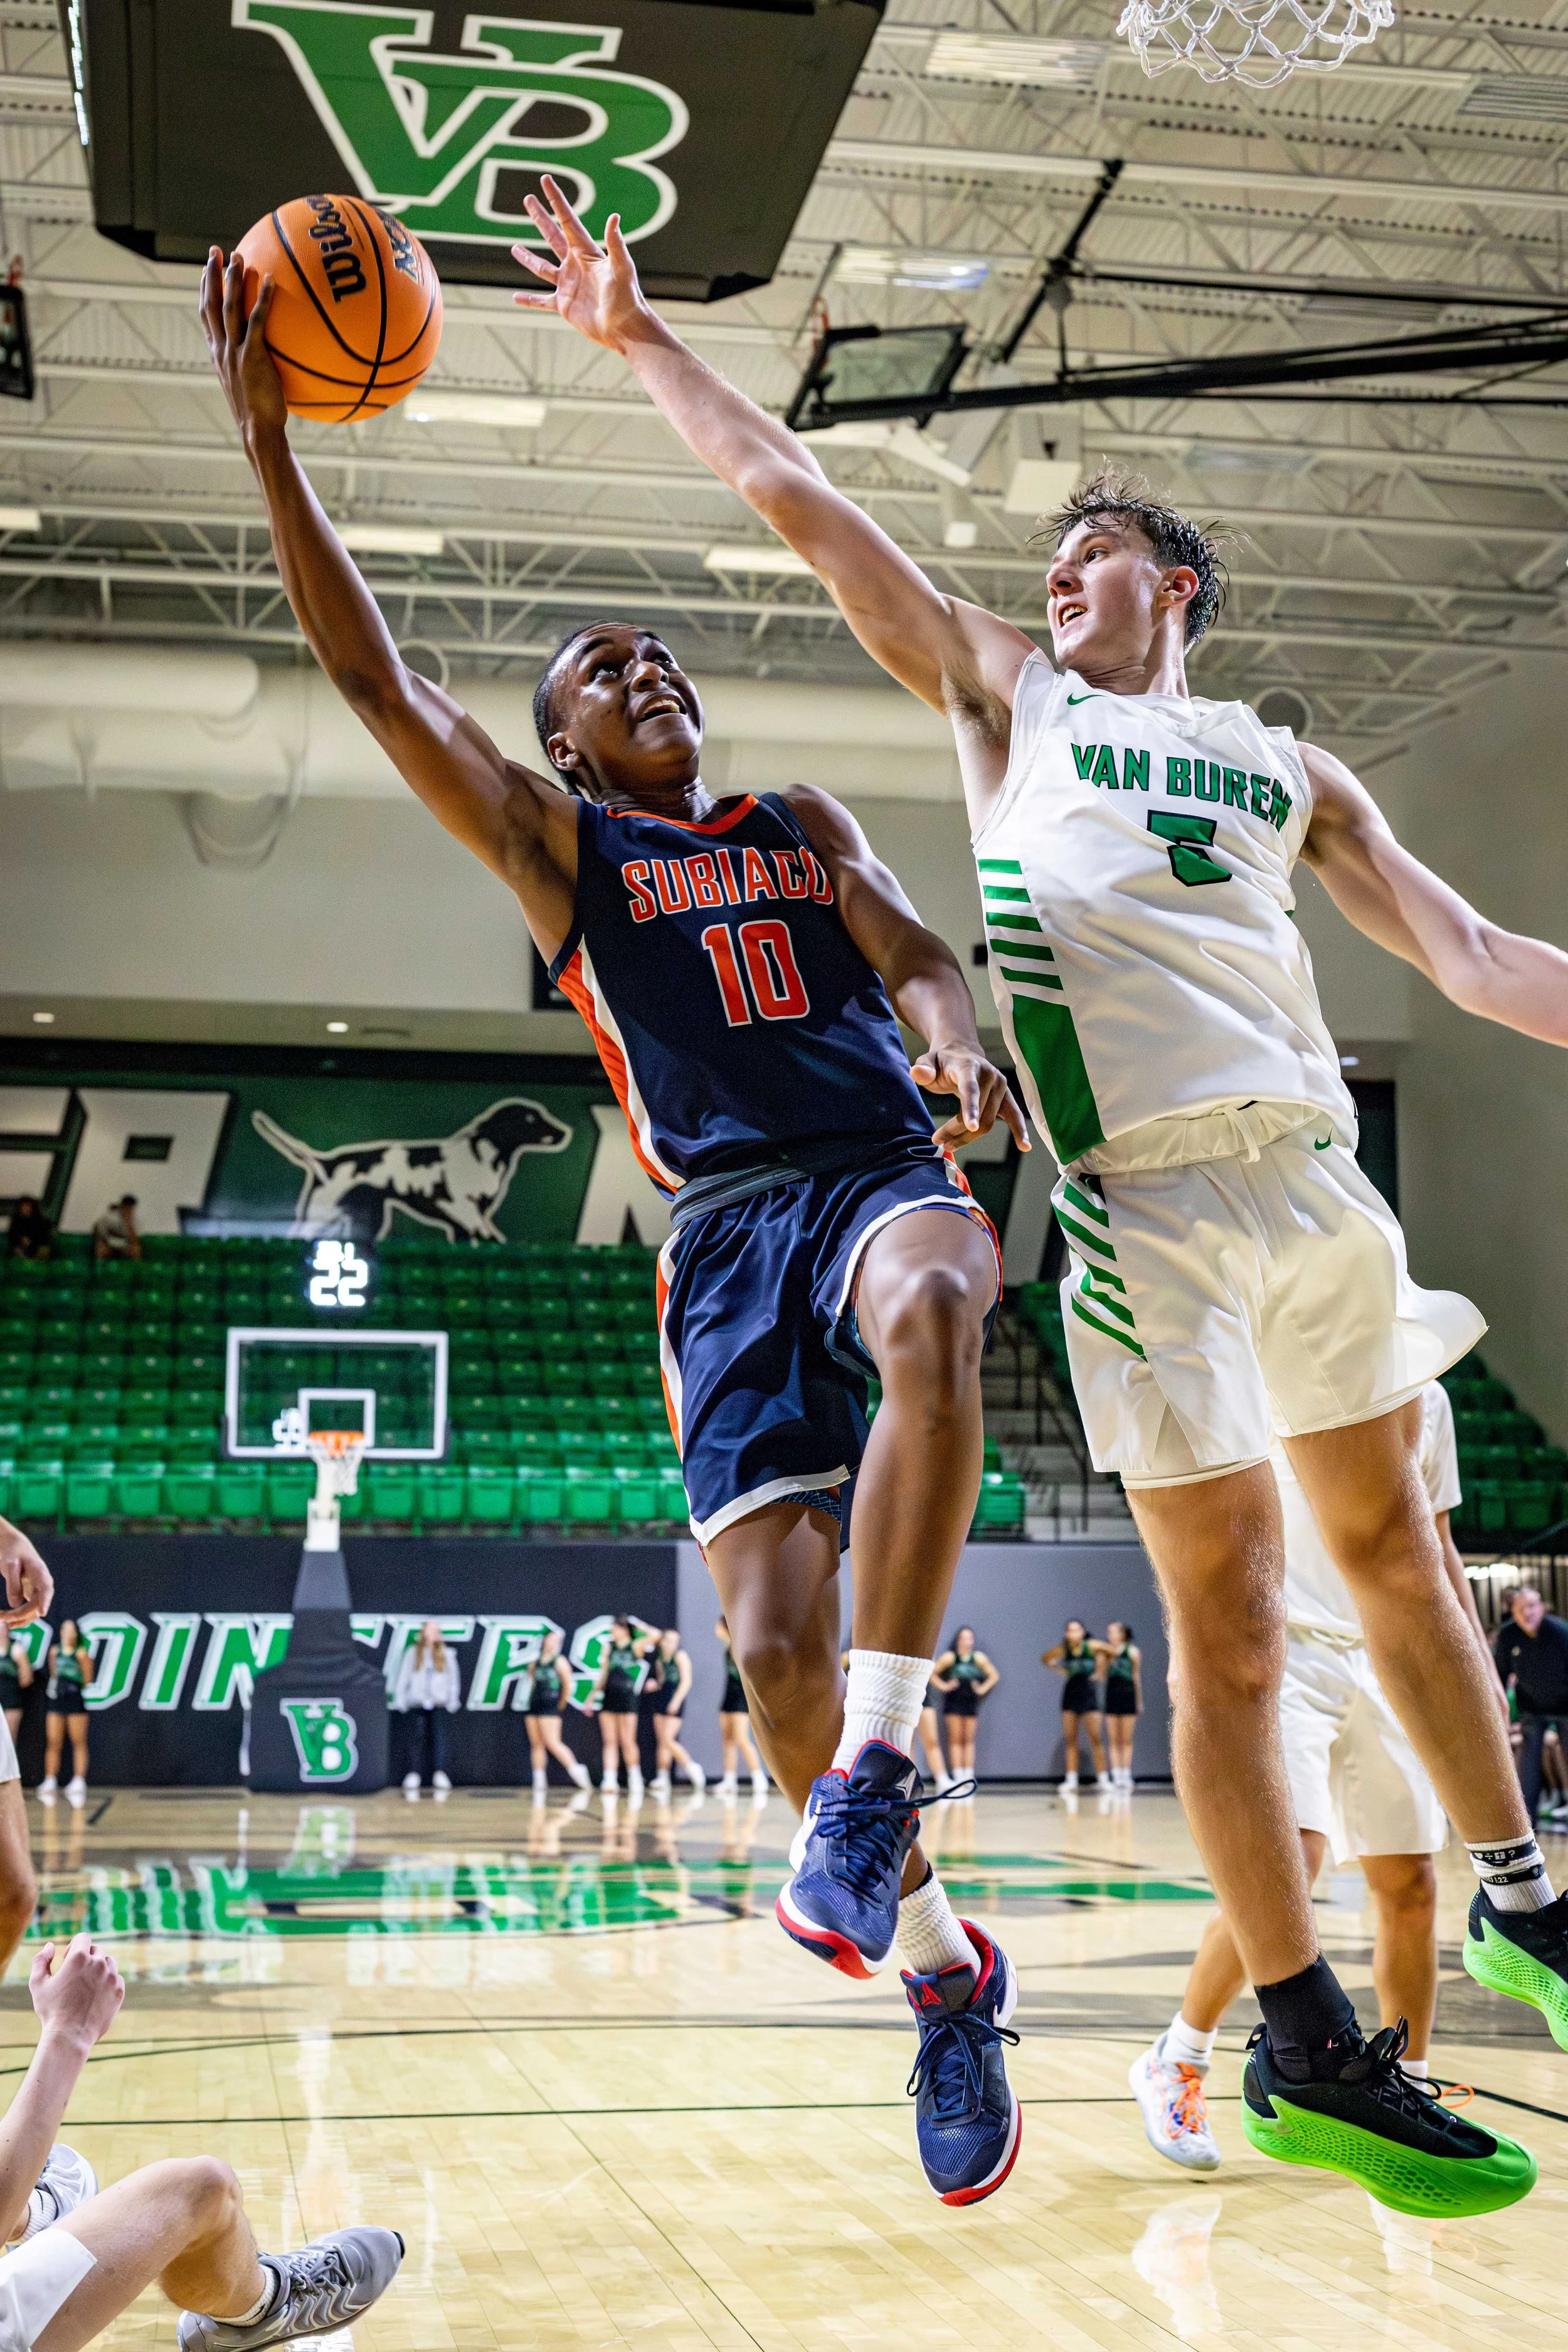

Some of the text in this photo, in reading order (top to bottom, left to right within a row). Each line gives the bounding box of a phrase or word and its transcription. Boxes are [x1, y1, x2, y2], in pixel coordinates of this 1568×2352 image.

[231, 0, 689, 247] VB
[1071, 743, 1292, 832] VAN BUREN
[622, 845, 834, 923] SUBIACO
[1147, 809, 1232, 887] 5
[701, 919, 810, 1027] 10
[310, 1259, 368, 1306] 22
[279, 1697, 359, 1783] VB
